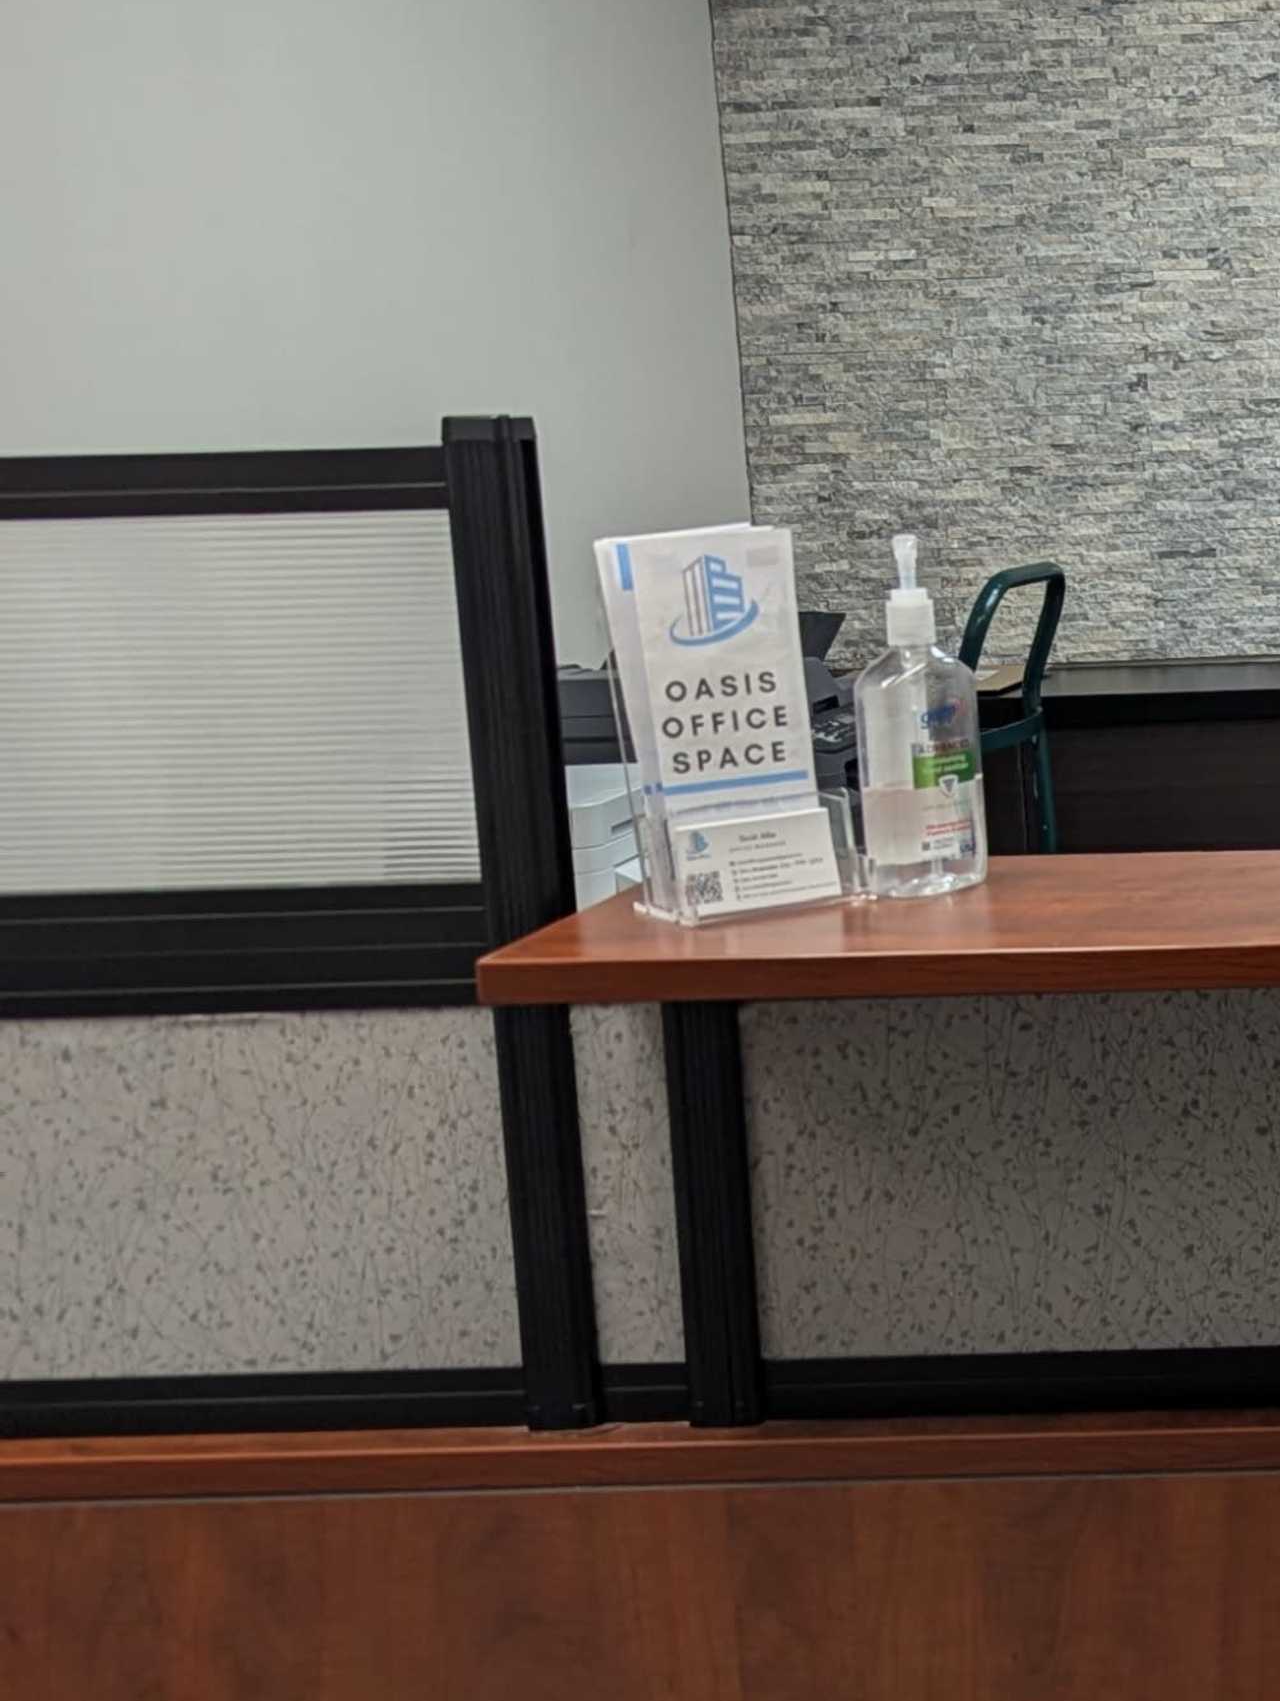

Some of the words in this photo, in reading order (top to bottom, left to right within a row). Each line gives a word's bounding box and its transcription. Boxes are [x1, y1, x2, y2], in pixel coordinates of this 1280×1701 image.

[665, 671, 777, 702] OASIS
[662, 705, 788, 739] OFFICE
[672, 740, 787, 775] SPACE
